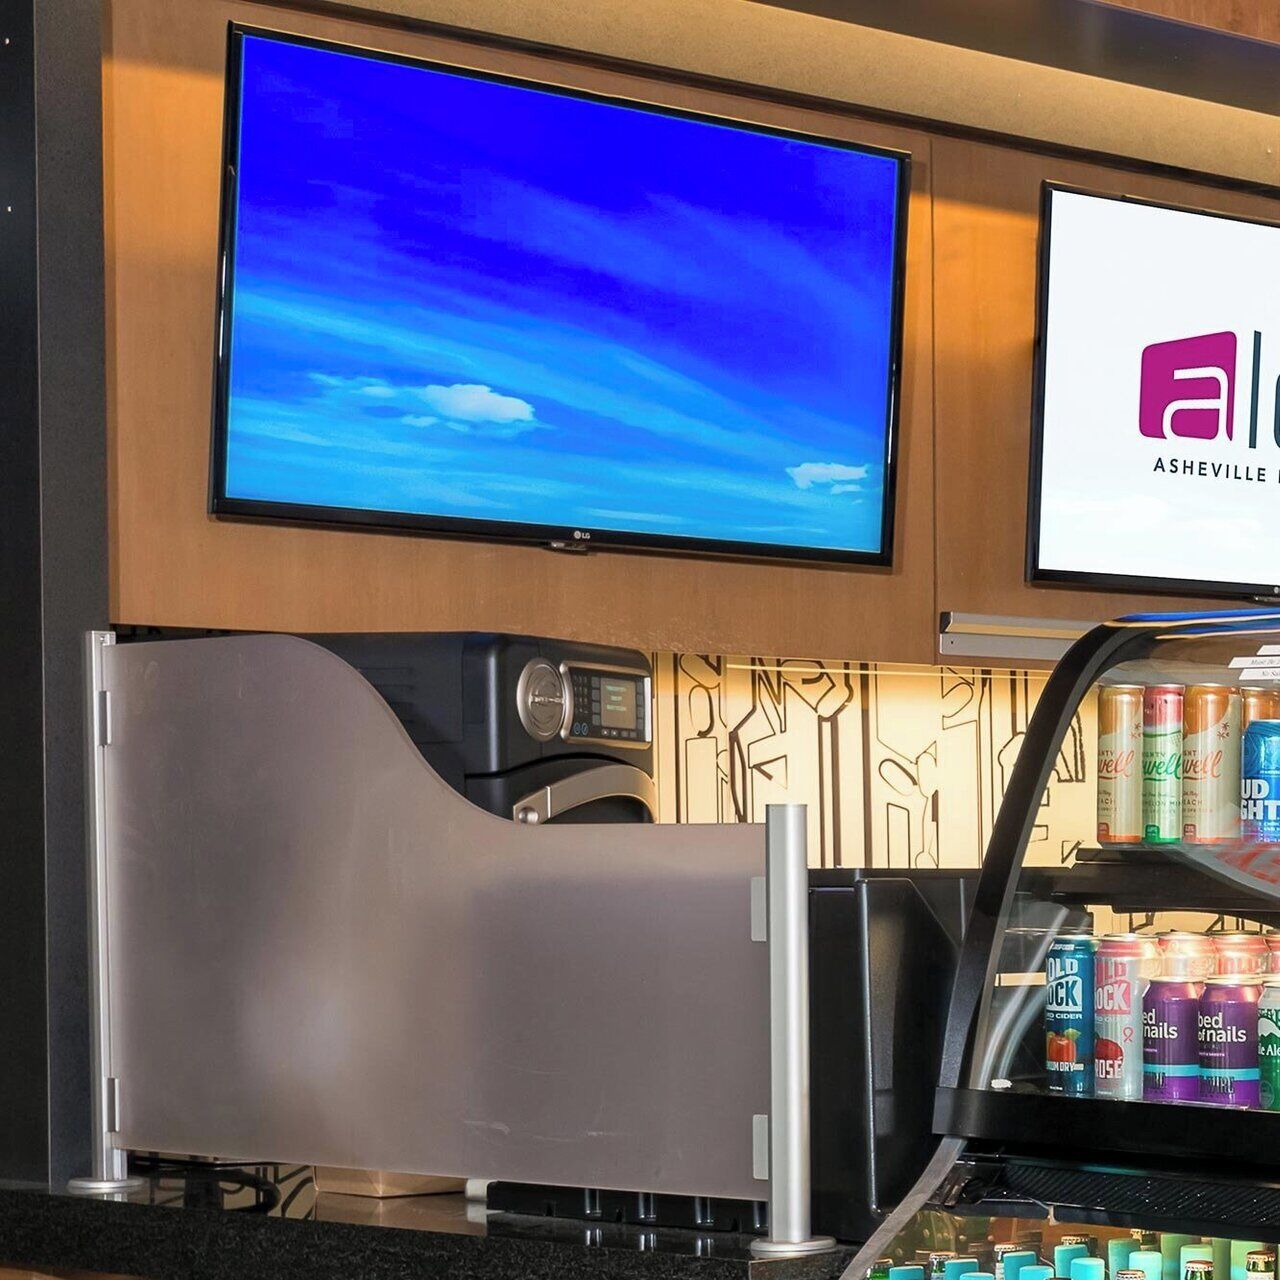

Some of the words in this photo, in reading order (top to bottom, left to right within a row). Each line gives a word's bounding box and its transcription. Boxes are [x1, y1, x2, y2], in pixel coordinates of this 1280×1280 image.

[1153, 457, 1267, 483] ASHEVILLE
[1199, 1012, 1223, 1027] bed
[1205, 1028, 1247, 1043] nails
